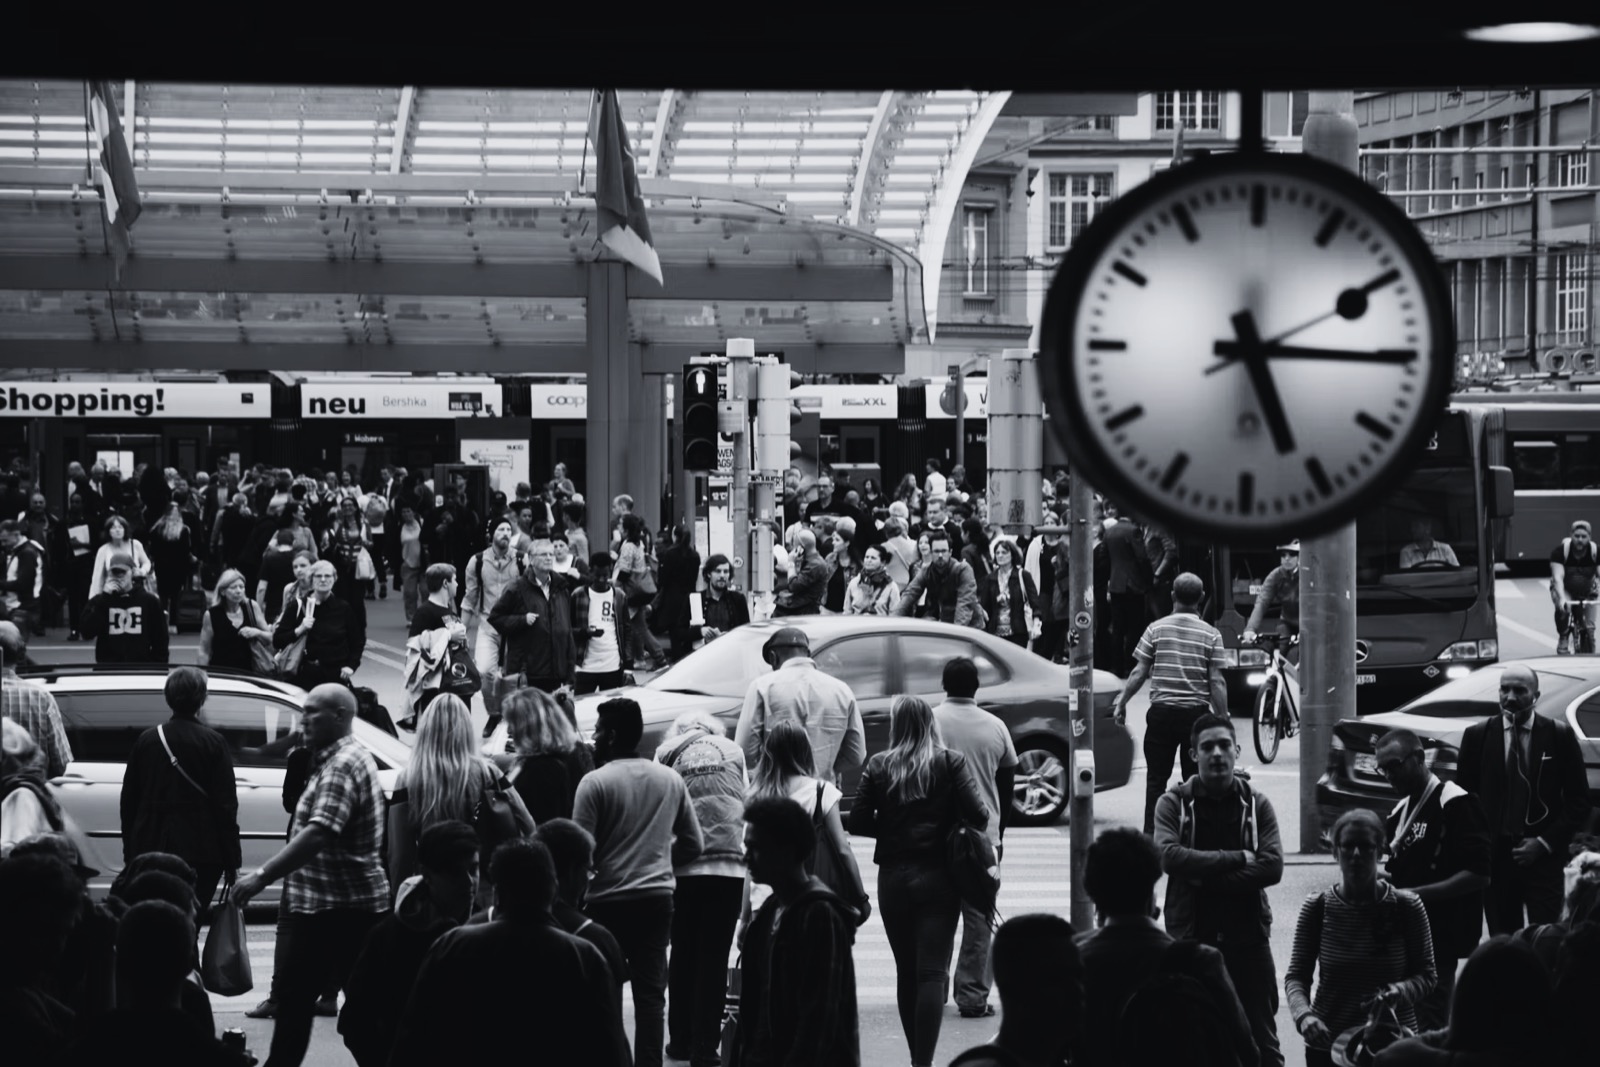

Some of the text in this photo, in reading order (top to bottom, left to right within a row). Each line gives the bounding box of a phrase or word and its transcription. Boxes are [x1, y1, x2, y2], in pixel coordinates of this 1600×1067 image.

[0, 387, 164, 416] Shopping!
[309, 397, 366, 414] neu
[383, 396, 427, 407] Bershka
[108, 606, 142, 635] DC
